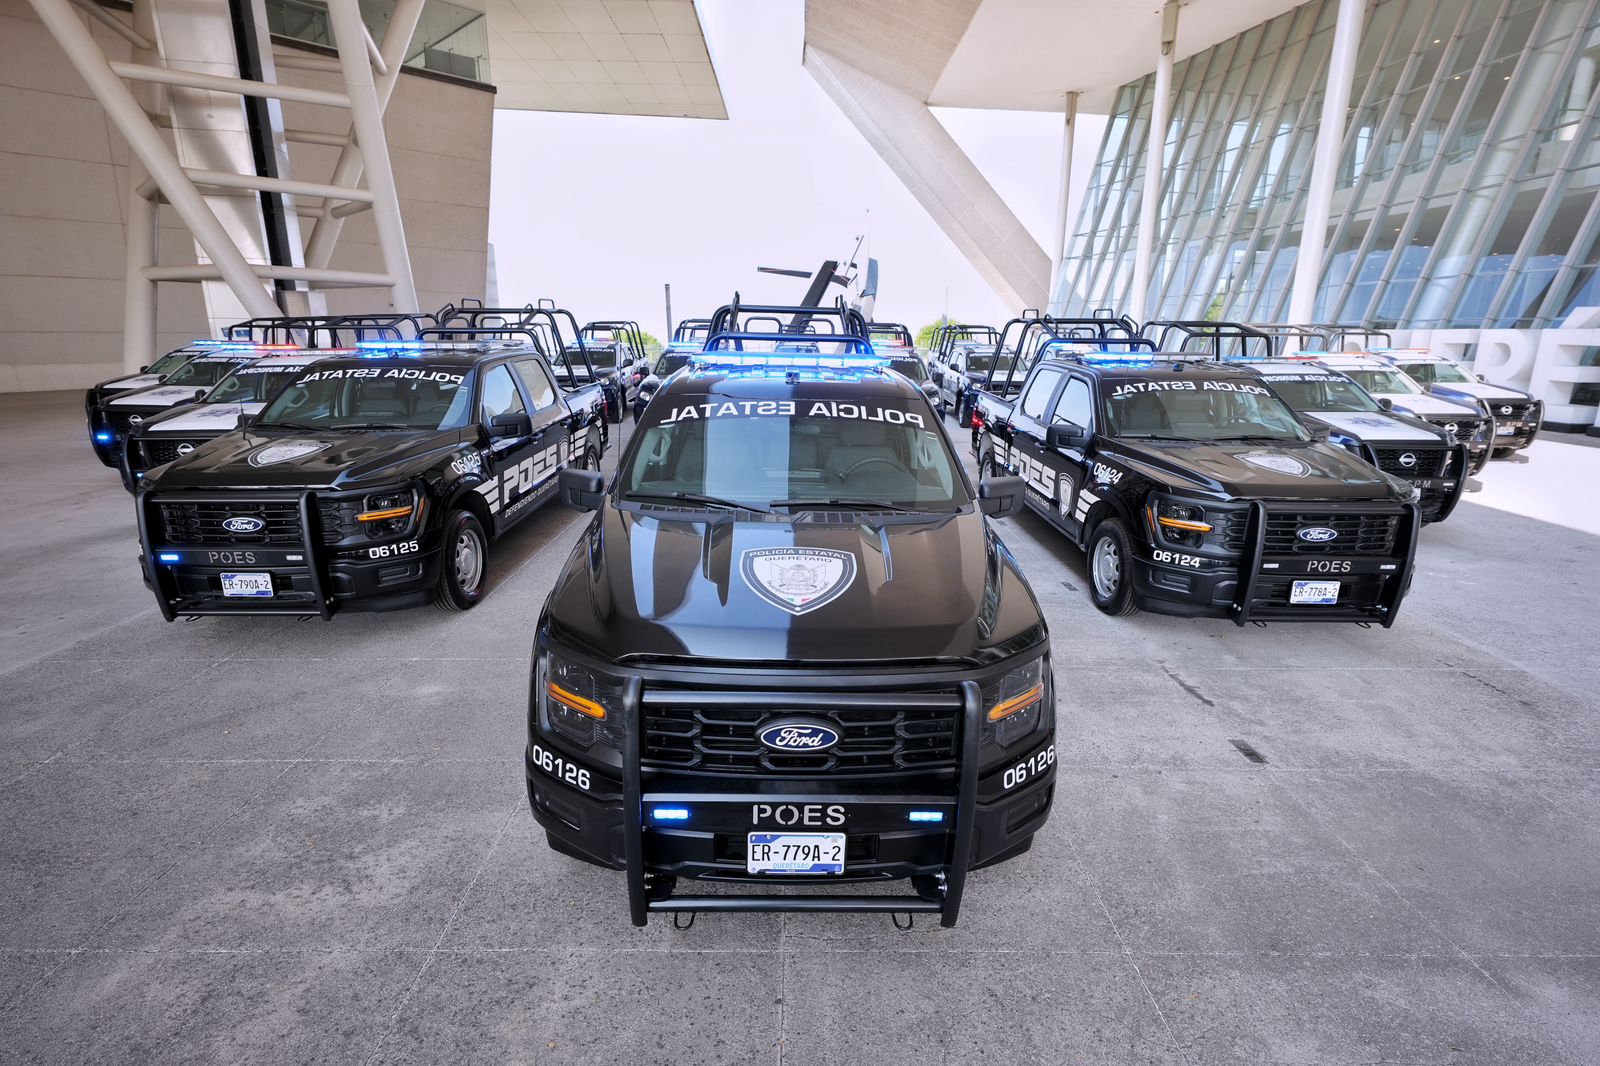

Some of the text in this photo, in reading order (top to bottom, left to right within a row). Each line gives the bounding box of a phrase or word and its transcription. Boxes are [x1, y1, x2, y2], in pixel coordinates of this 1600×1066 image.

[451, 452, 482, 475] 06125
[1010, 446, 1057, 499] POES
[503, 443, 558, 505] POES
[1093, 462, 1124, 485] 06124
[230, 520, 254, 530] Ford
[1306, 528, 1330, 539] Ford
[208, 551, 256, 564] POES
[369, 540, 419, 559] 06125
[749, 549, 849, 559] POLICÍA ESTATAL
[1153, 549, 1200, 568] 06124
[1306, 560, 1352, 572] POES
[223, 579, 270, 590] ER-790A-2
[1293, 587, 1337, 598] ER-778A-2
[775, 728, 823, 747] Ford
[533, 745, 590, 790] 06126
[1003, 744, 1055, 789] 06126
[752, 804, 846, 826] POES
[751, 844, 841, 861] ER-779A-2
